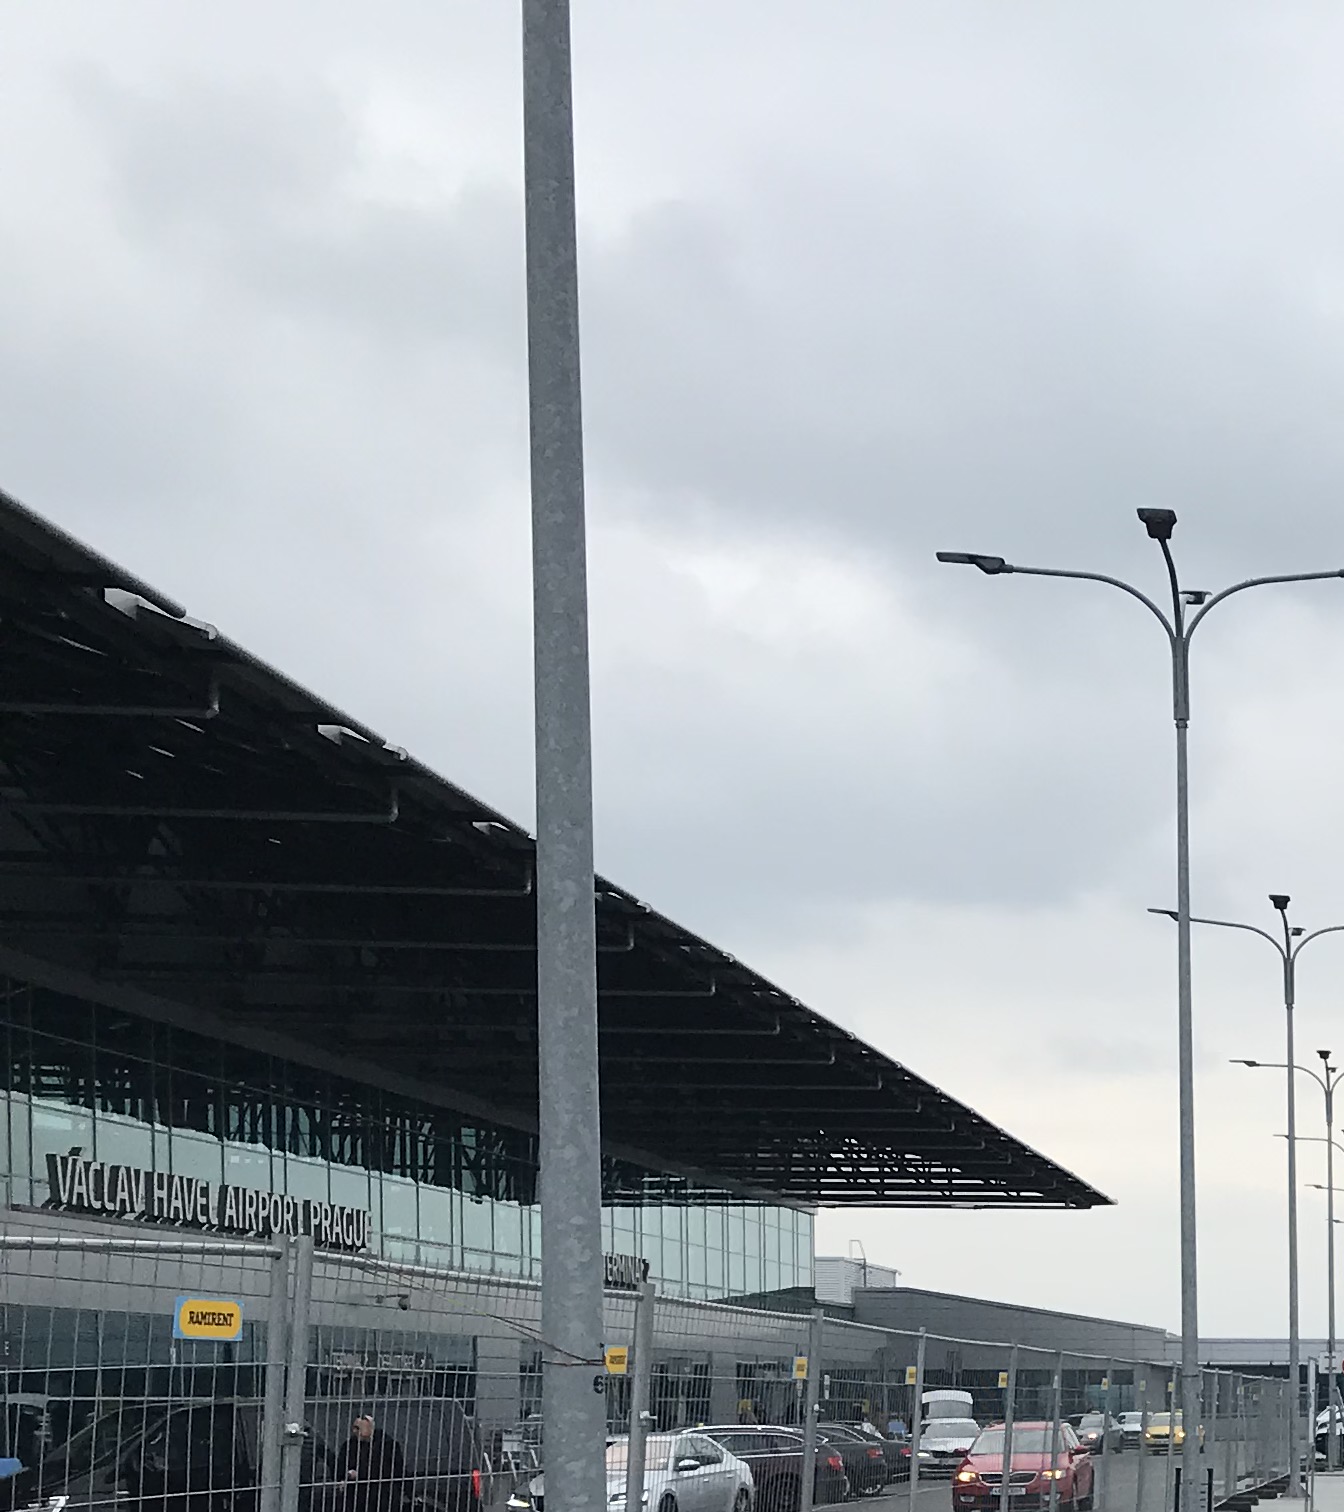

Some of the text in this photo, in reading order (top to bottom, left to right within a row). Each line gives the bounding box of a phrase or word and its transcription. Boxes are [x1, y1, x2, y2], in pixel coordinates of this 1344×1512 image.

[54, 1147, 373, 1249] VÁCLAV HAVEL AIRPORT PRAGUE
[188, 1310, 234, 1327] RAMIRENT
